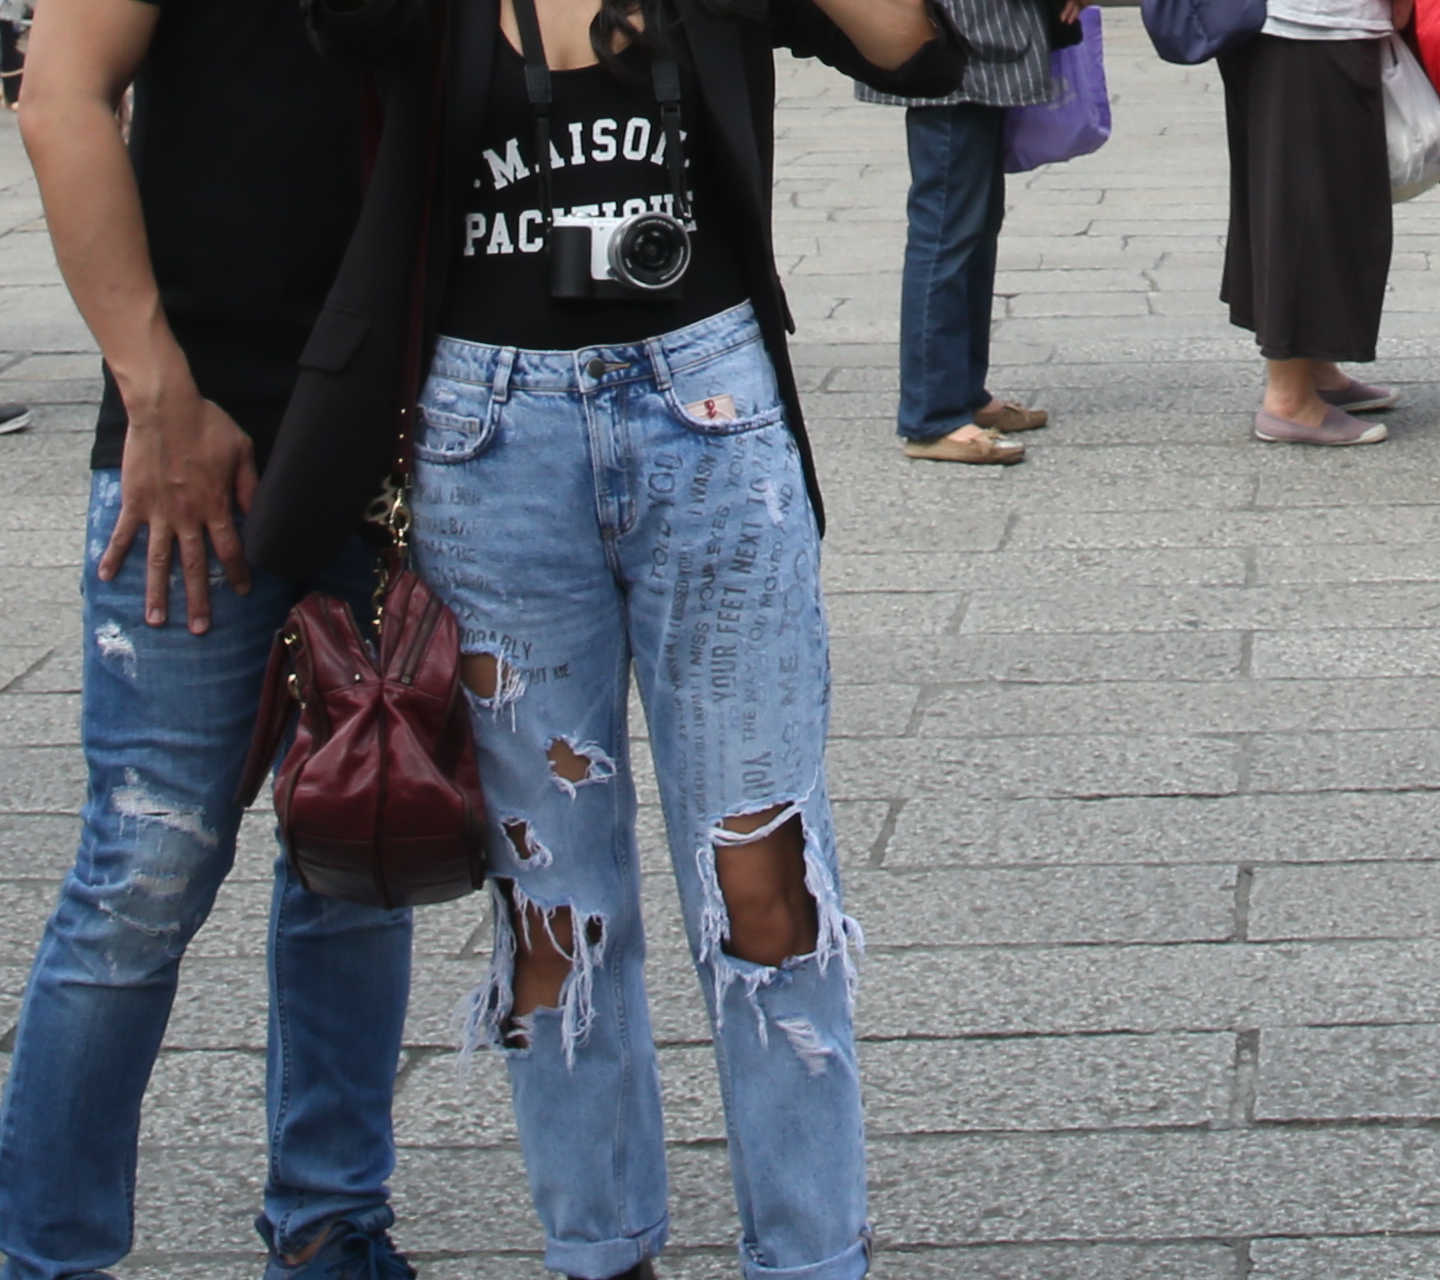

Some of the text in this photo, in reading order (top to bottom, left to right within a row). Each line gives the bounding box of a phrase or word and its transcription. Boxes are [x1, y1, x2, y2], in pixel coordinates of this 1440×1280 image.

[649, 518, 671, 578] TOLD
[728, 521, 763, 574] NEXT
[715, 586, 747, 634] FEET
[690, 622, 709, 666] MISS
[711, 644, 738, 704] YOUR
